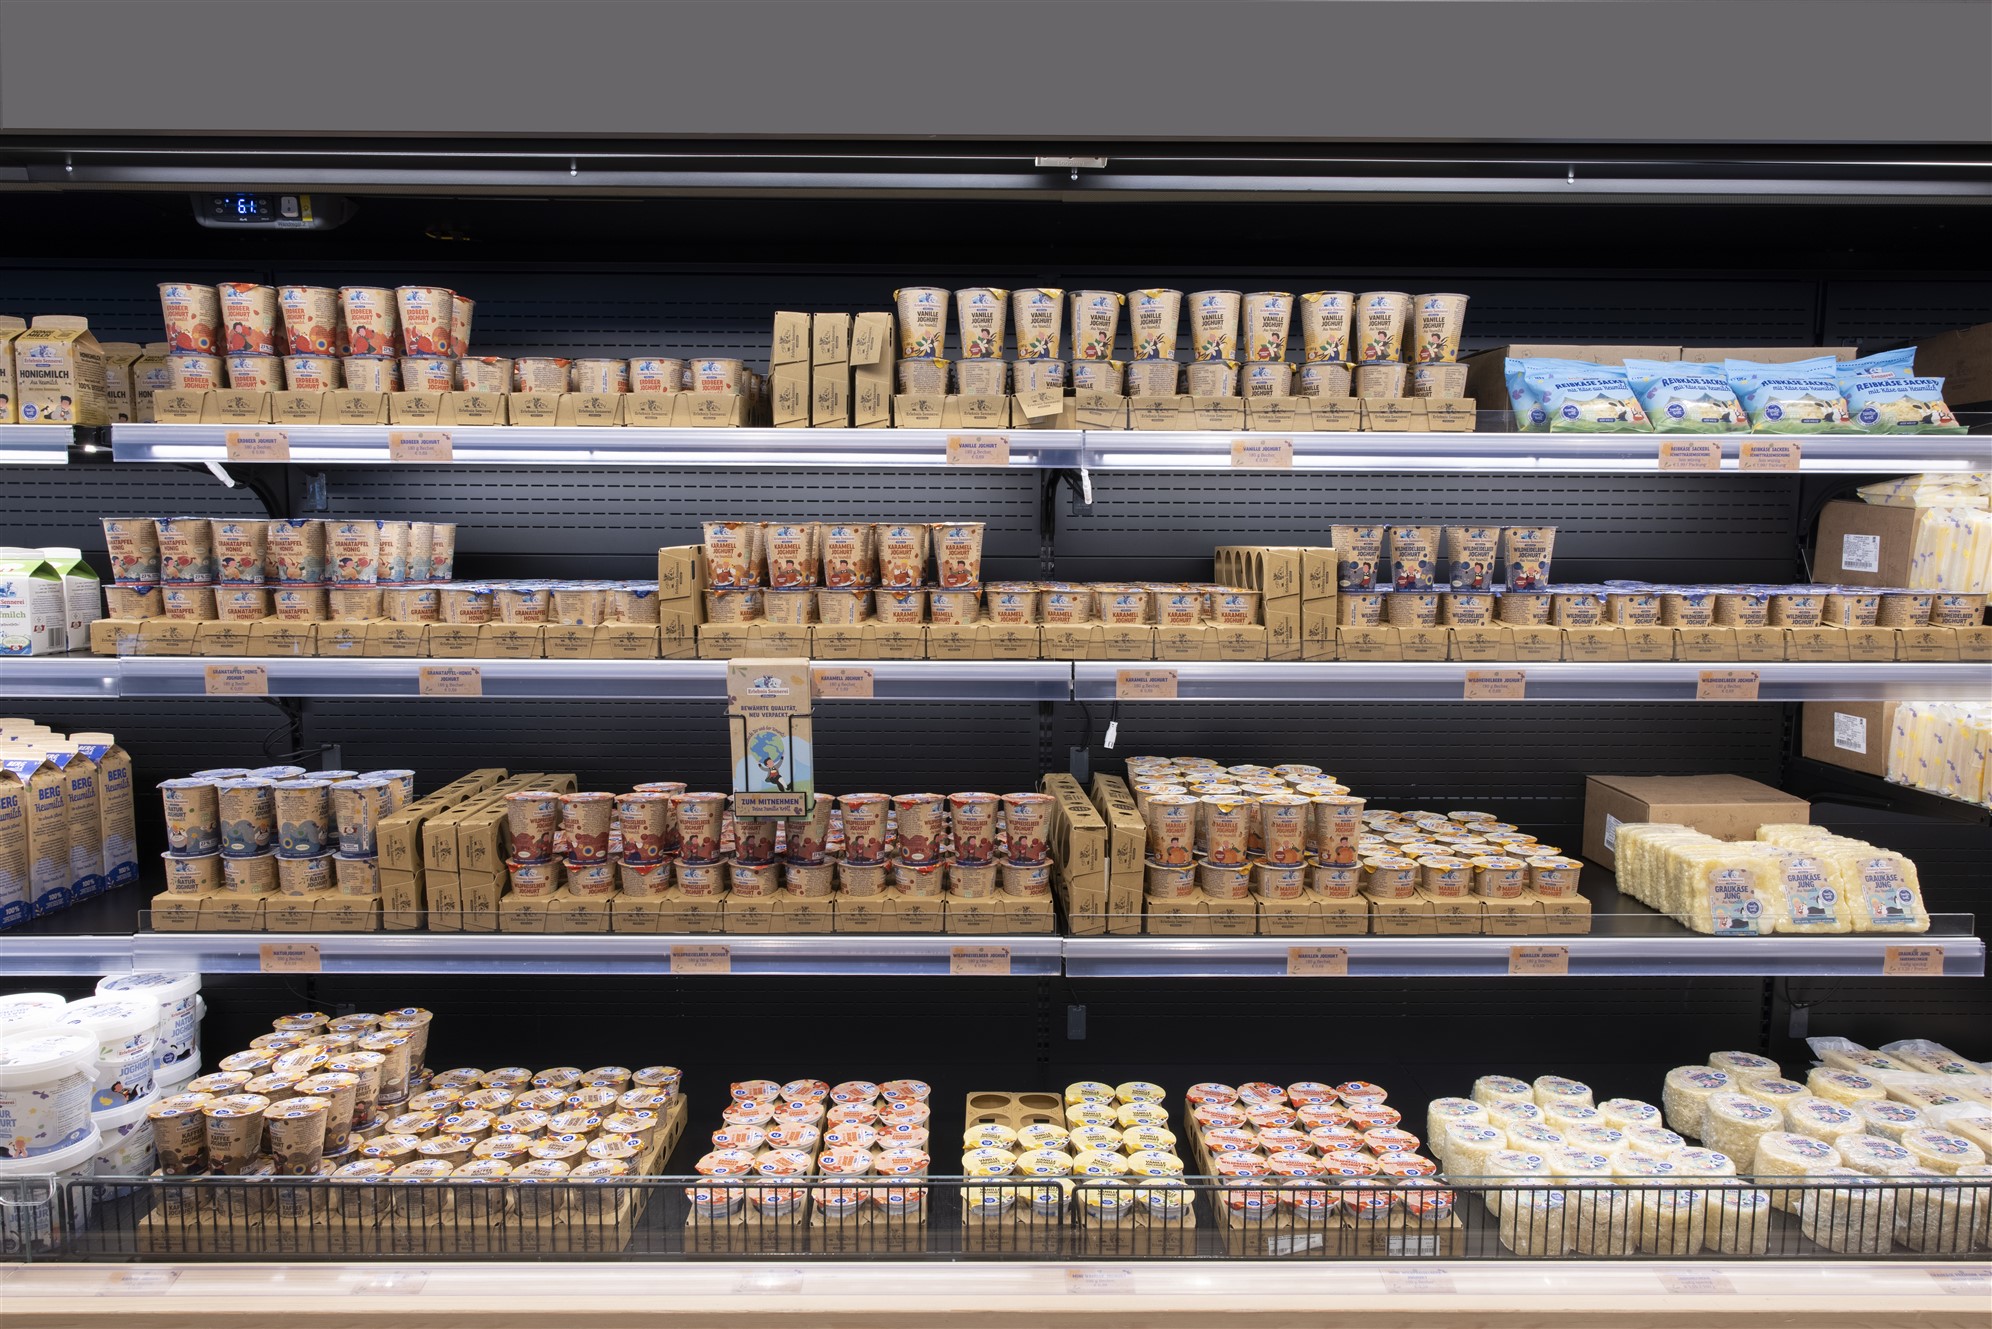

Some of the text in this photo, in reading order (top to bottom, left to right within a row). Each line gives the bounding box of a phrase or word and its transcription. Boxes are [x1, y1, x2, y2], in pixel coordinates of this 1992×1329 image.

[20, 370, 69, 379] HONIGMILCH
[1555, 380, 1592, 390] REIBKÄSE
[1662, 377, 1700, 386] REIBKÄSE
[1761, 379, 1802, 387] REIBKÄSE
[1856, 381, 1894, 392] REIBKÄSE
[108, 768, 127, 781] BERG
[72, 777, 92, 791] BERG
[105, 779, 129, 792] Heumilch
[39, 786, 60, 800] BERG
[68, 786, 96, 802] Heumilch
[35, 796, 64, 812] Heumilch
[1788, 873, 1821, 881] GRAUKÄSE
[1865, 873, 1898, 882] GRAUKÄSE
[1715, 885, 1749, 893] GRAUKÄSE
[174, 1014, 194, 1028] NATUR
[119, 1058, 151, 1077] JOGHURT
